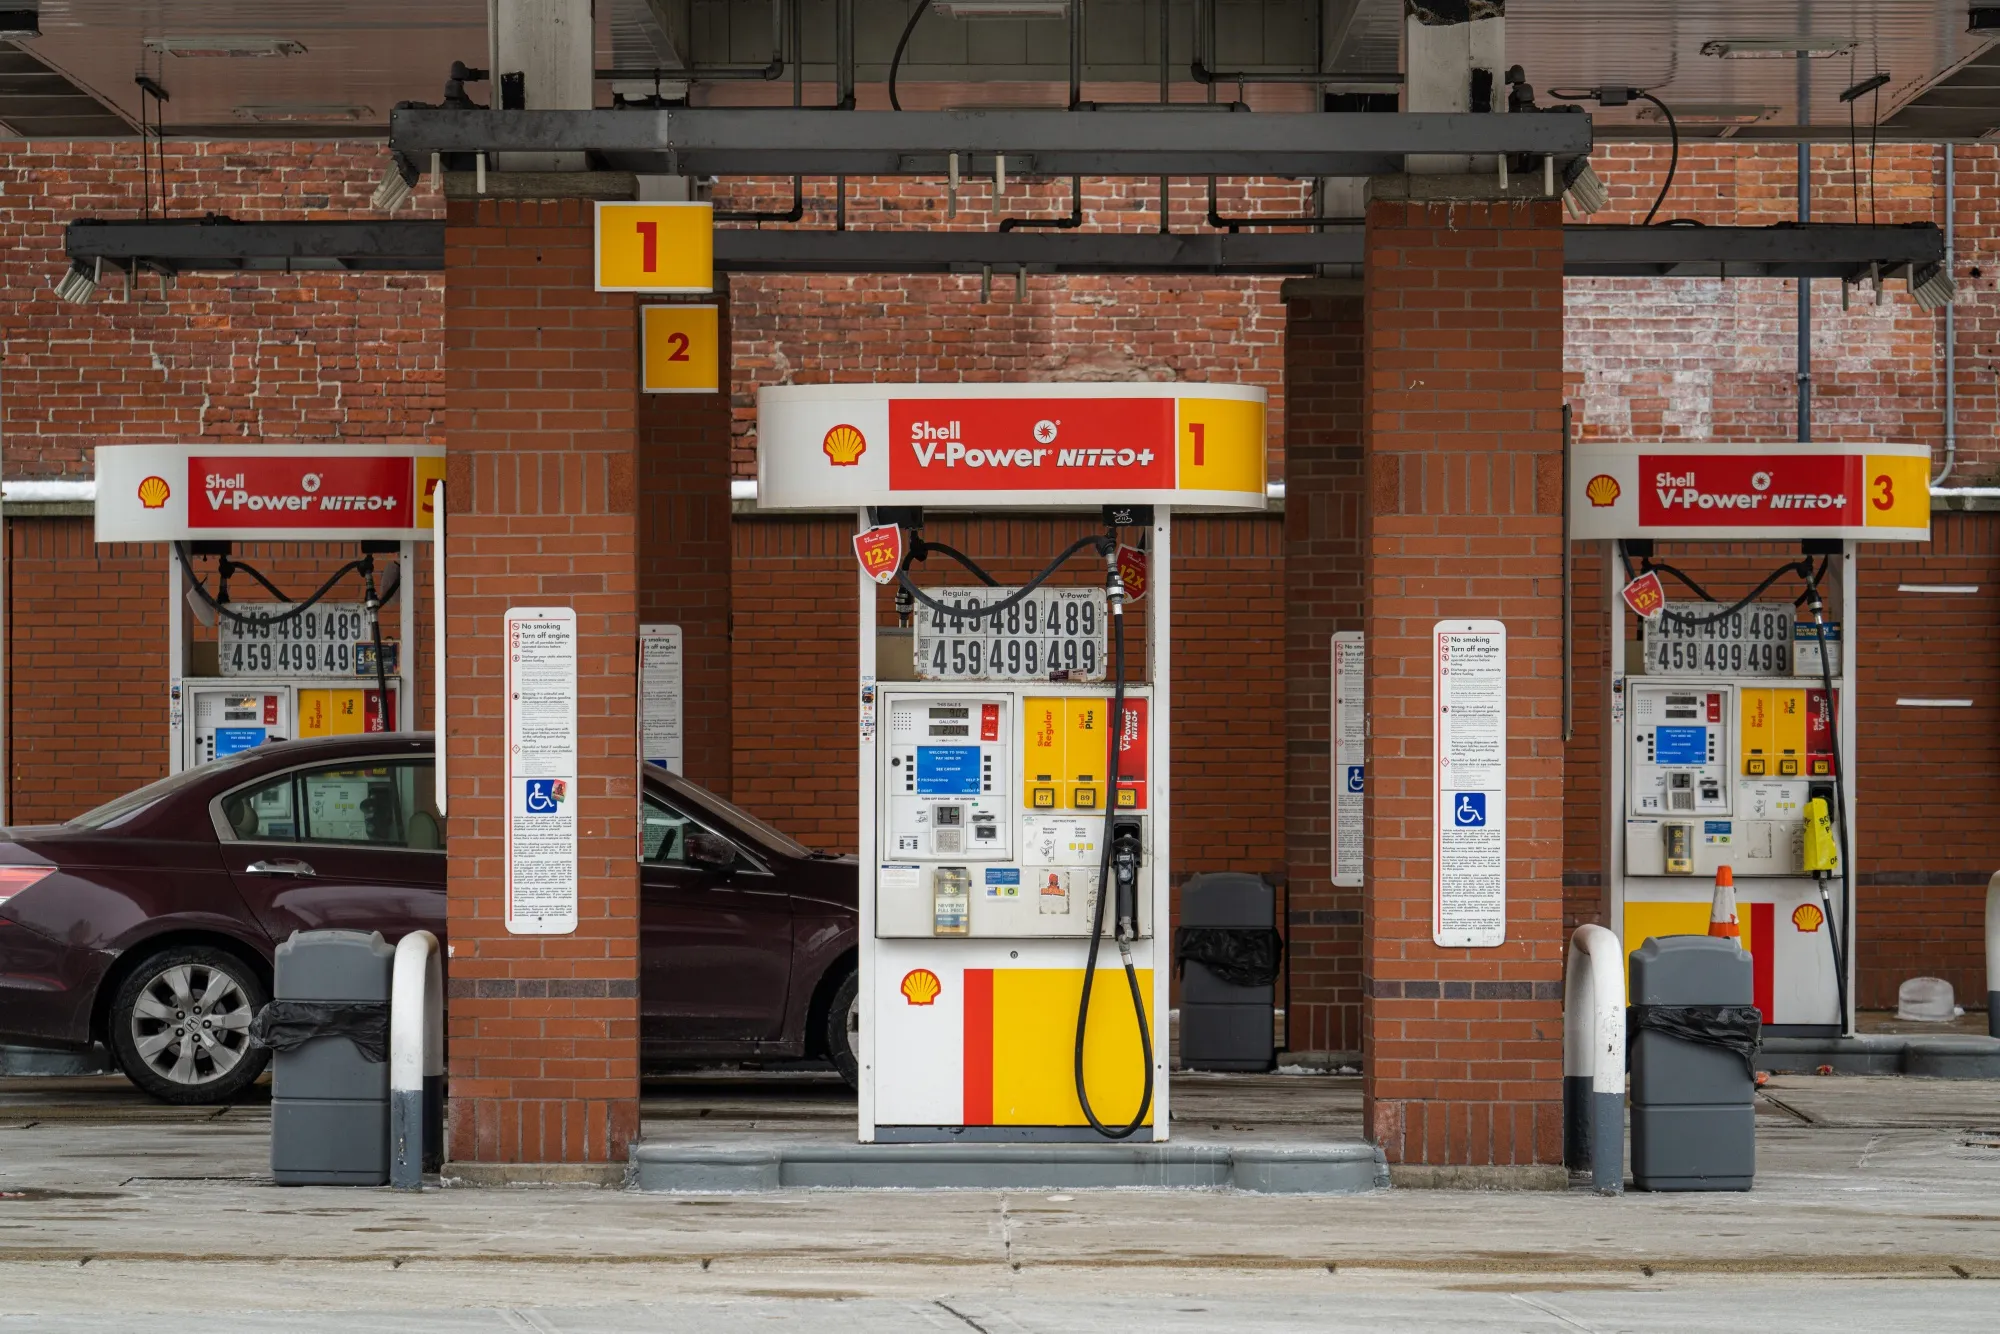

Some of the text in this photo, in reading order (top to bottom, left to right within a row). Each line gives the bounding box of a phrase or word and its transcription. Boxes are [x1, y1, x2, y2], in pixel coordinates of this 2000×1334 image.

[637, 222, 657, 272] 1
[668, 332, 689, 361] 2
[911, 421, 960, 440] Shell
[1188, 423, 1205, 466] 1
[206, 474, 244, 488] Shell
[1656, 472, 1695, 487] Shell
[1872, 475, 1894, 510] 3
[232, 612, 270, 639] 449
[278, 612, 317, 640] 489
[324, 612, 361, 640] 489
[932, 598, 981, 634] 449
[990, 601, 1037, 635] 489
[1047, 601, 1095, 636] 489
[1659, 611, 1695, 638] 449
[1704, 612, 1742, 639] 489
[1750, 613, 1787, 640] 489
[1463, 636, 1490, 644] smoking
[278, 643, 317, 671] 499
[324, 643, 355, 671] 49
[933, 640, 981, 674] 459
[990, 640, 1037, 674] 499
[1047, 640, 1095, 674] 499
[1659, 643, 1697, 670] 459
[1704, 644, 1741, 671] 499
[1748, 644, 1786, 671] 499
[1044, 710, 1054, 747] Regular
